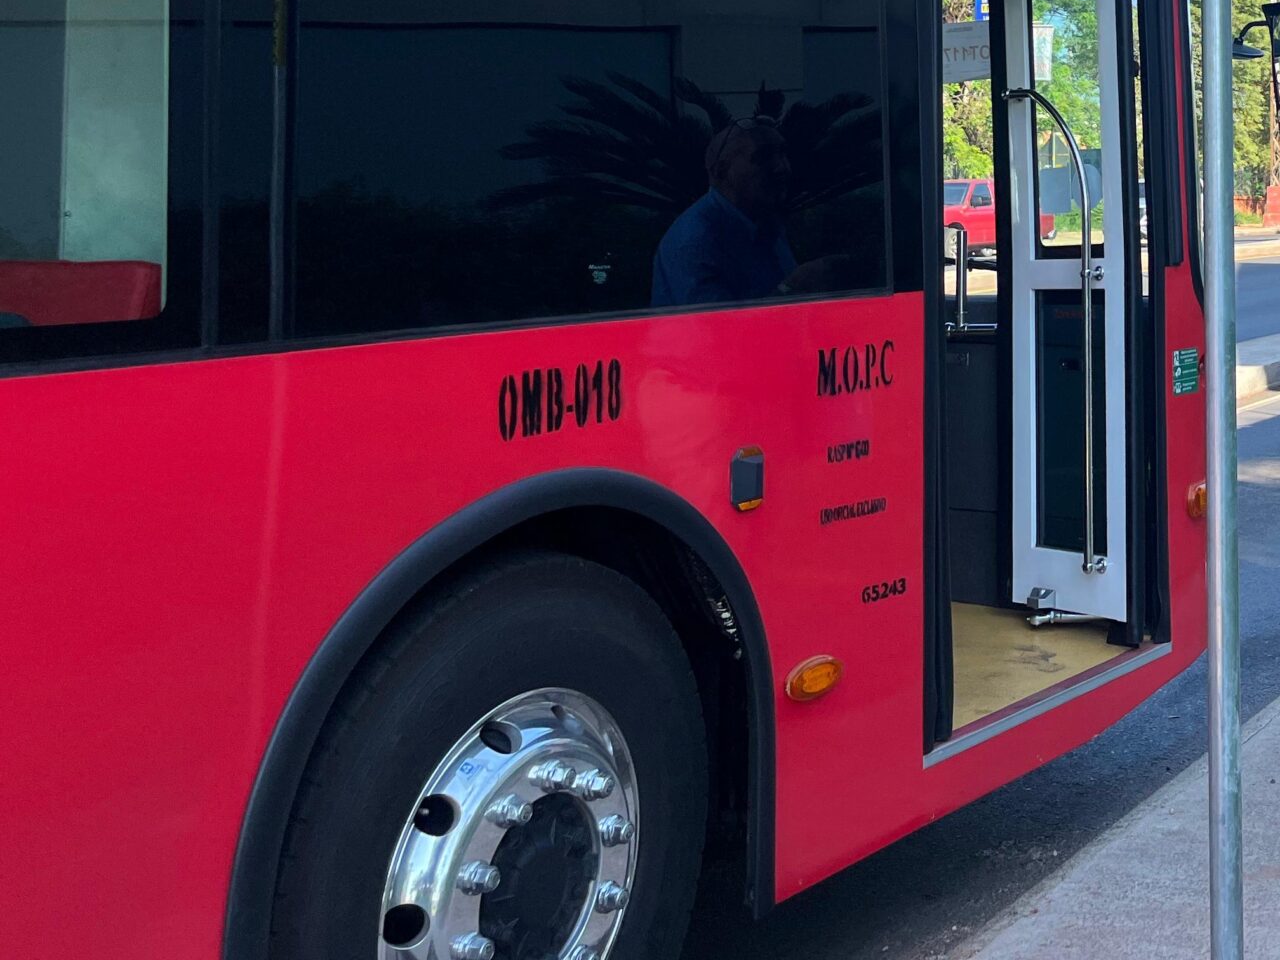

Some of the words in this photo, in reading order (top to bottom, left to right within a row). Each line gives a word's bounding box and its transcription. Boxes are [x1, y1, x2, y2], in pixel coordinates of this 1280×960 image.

[817, 339, 895, 397] M.O.P.C
[498, 358, 621, 442] OMB-018
[861, 577, 906, 604] 65243
